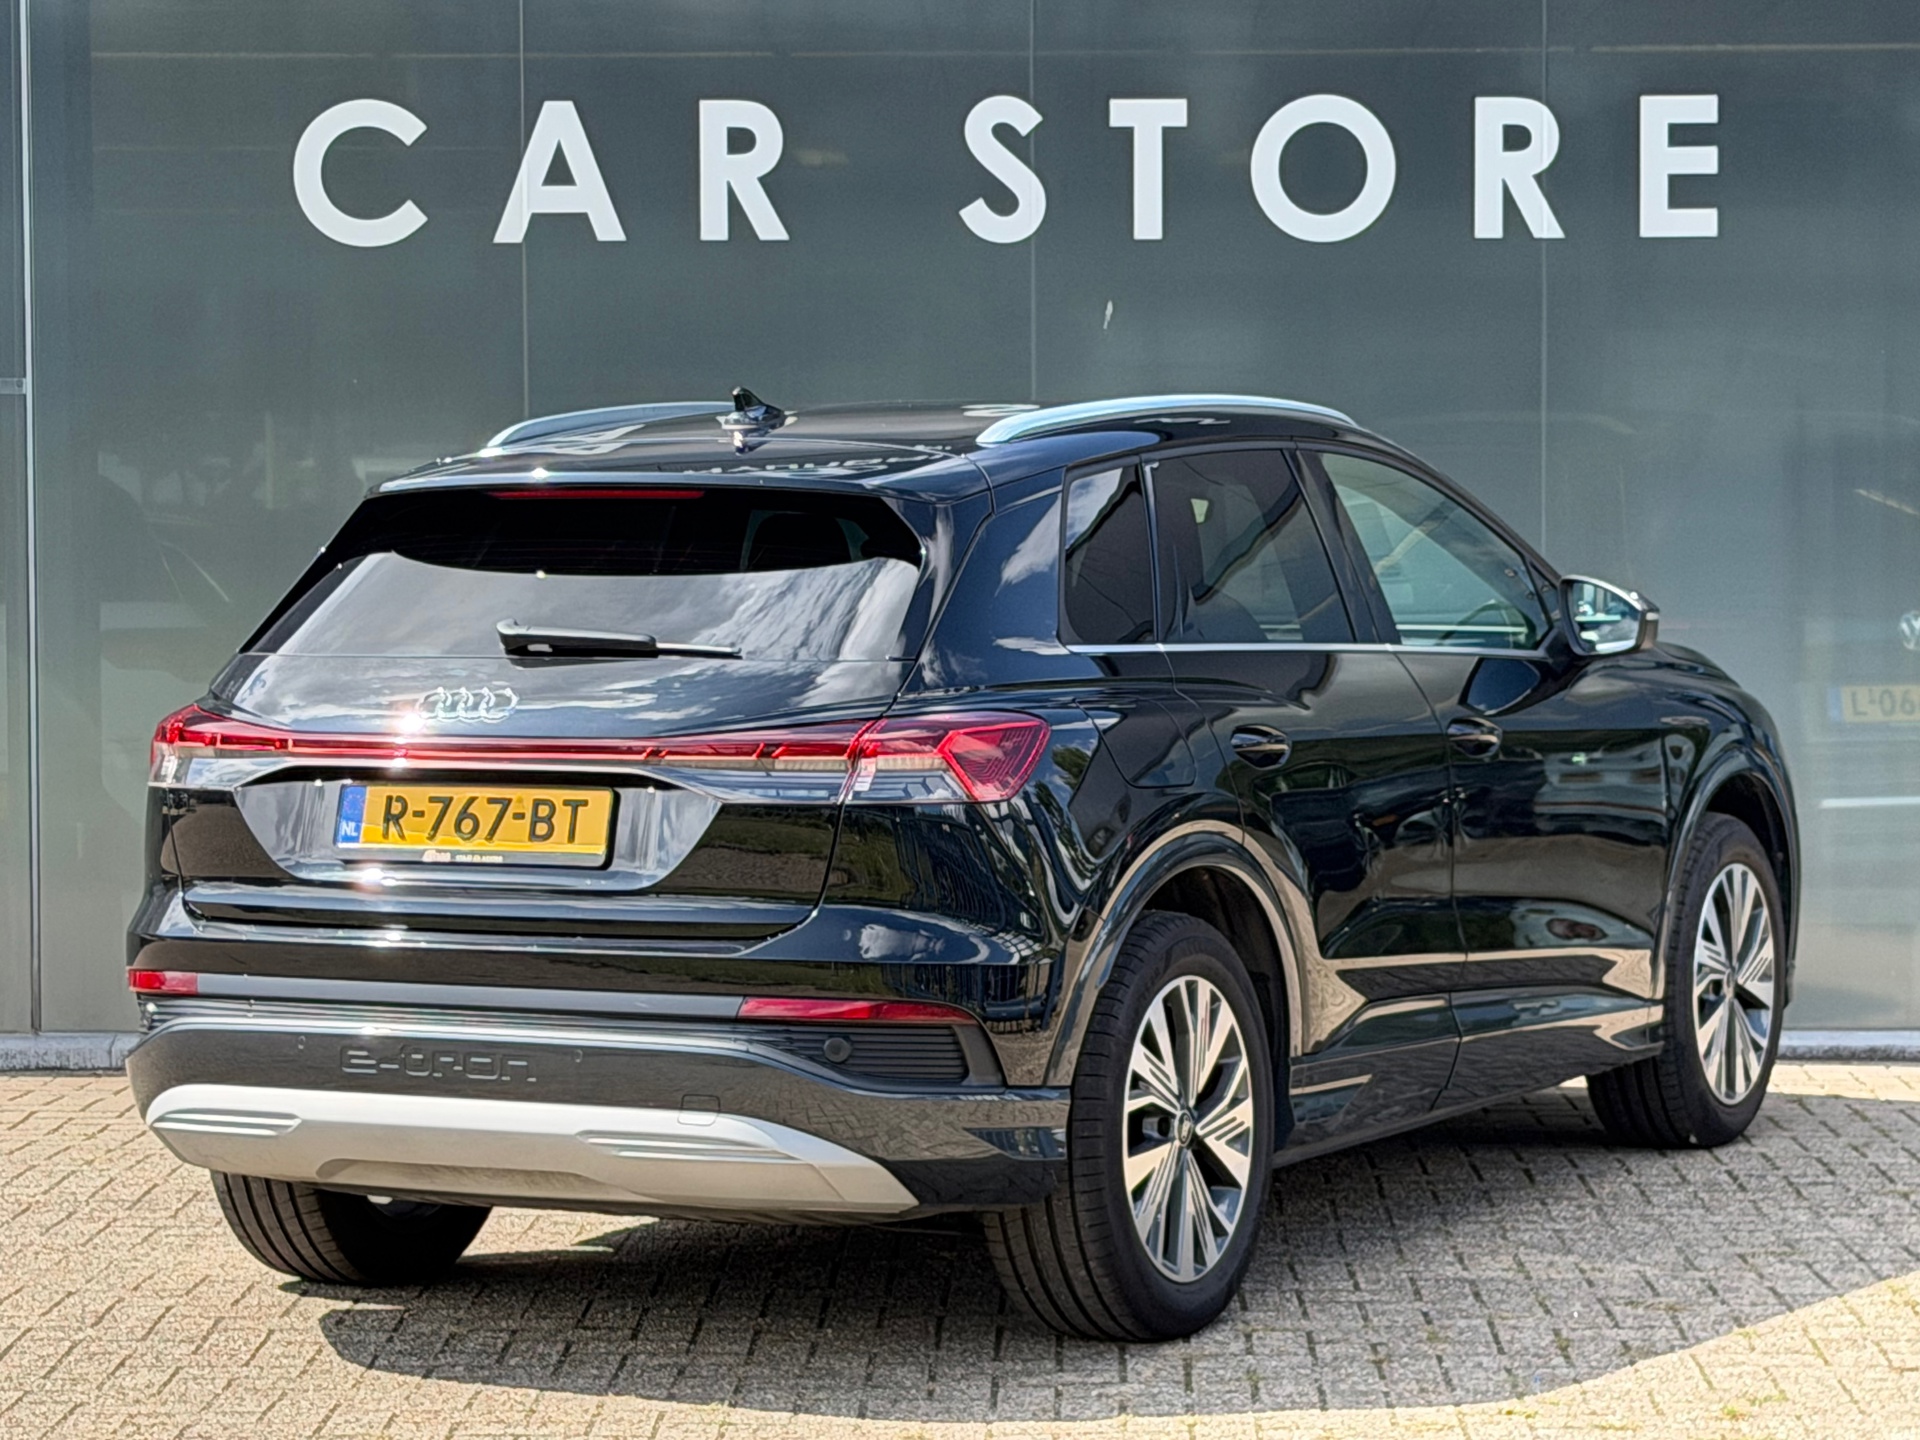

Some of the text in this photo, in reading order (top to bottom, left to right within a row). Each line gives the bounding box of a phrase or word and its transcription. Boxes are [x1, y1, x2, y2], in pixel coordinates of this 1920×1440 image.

[294, 94, 1718, 247] CAR STORE
[340, 819, 359, 837] NL
[382, 794, 589, 843] R-767-BT
